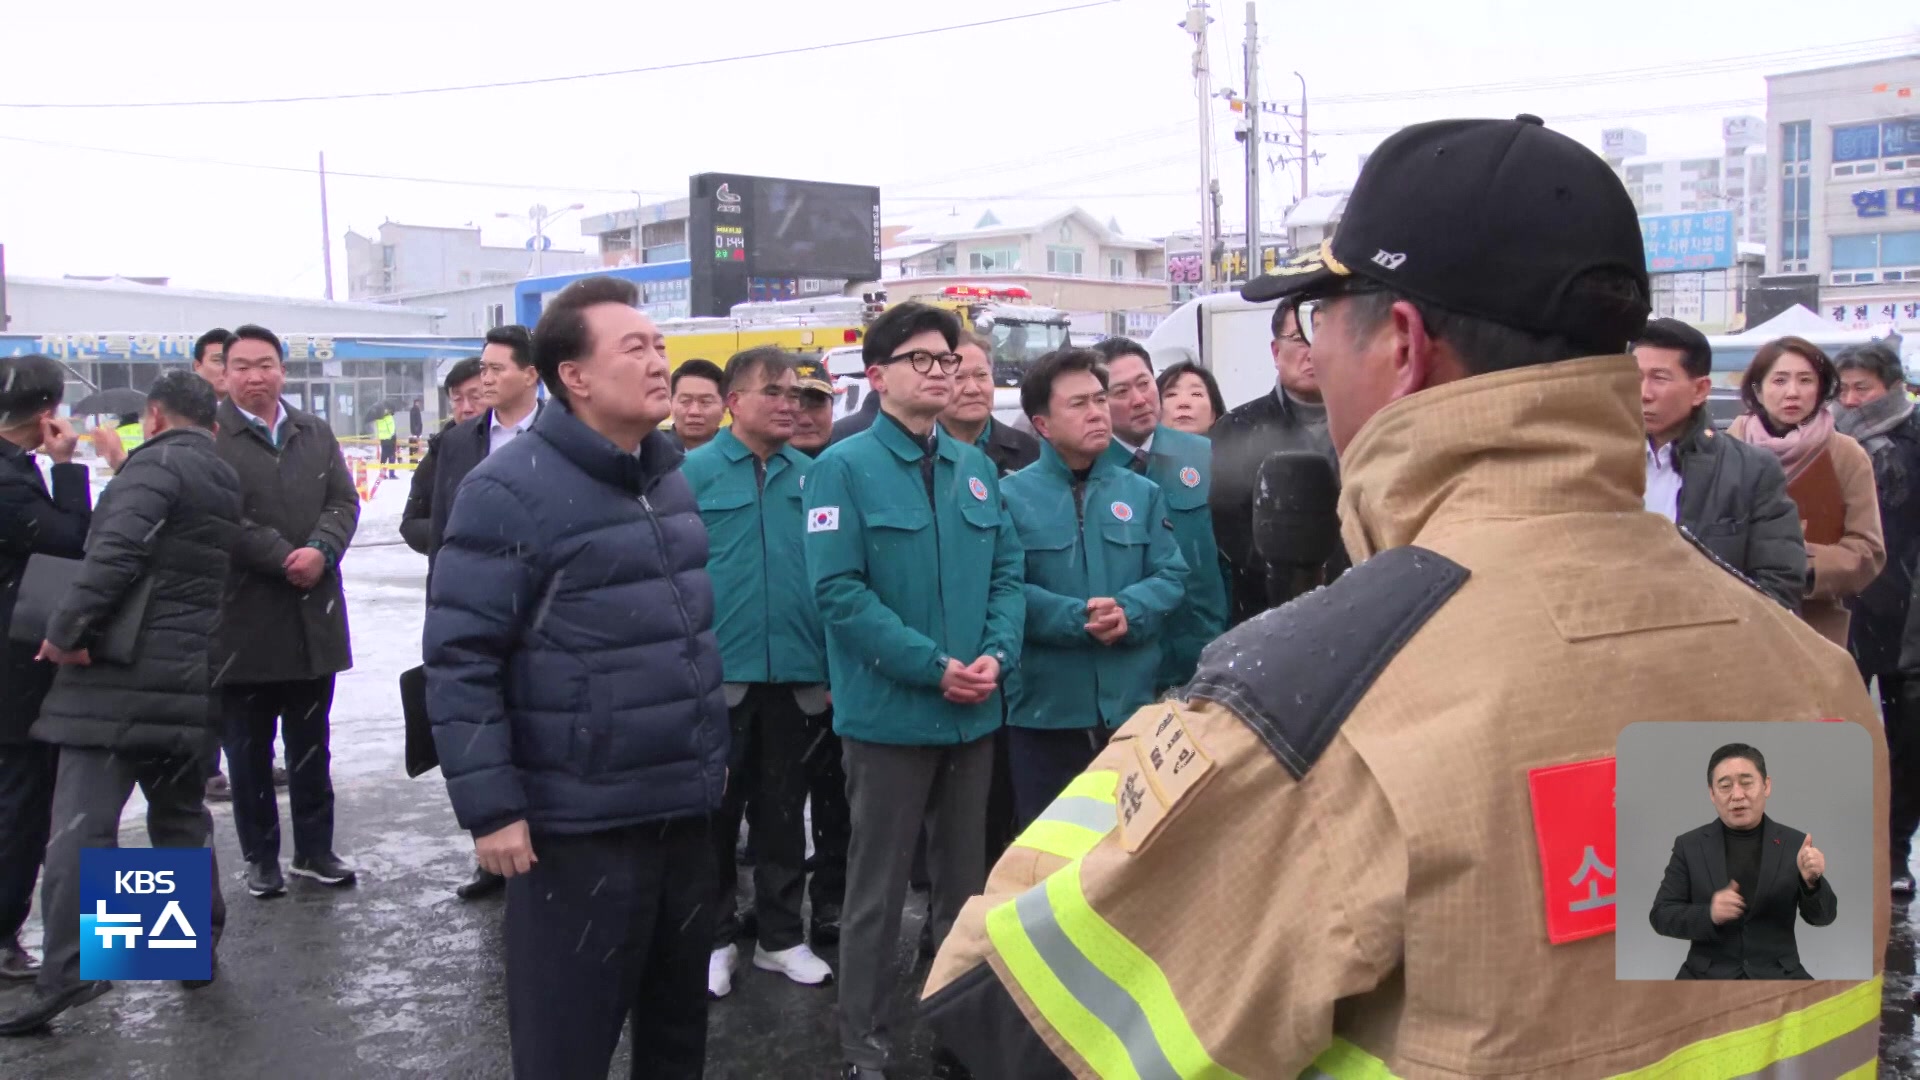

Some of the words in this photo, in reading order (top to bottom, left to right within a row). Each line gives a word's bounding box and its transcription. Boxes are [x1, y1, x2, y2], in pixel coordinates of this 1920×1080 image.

[1370, 249, 1407, 271] 119
[41, 335, 195, 360] 서천특화시
[1568, 845, 1616, 912] 소
